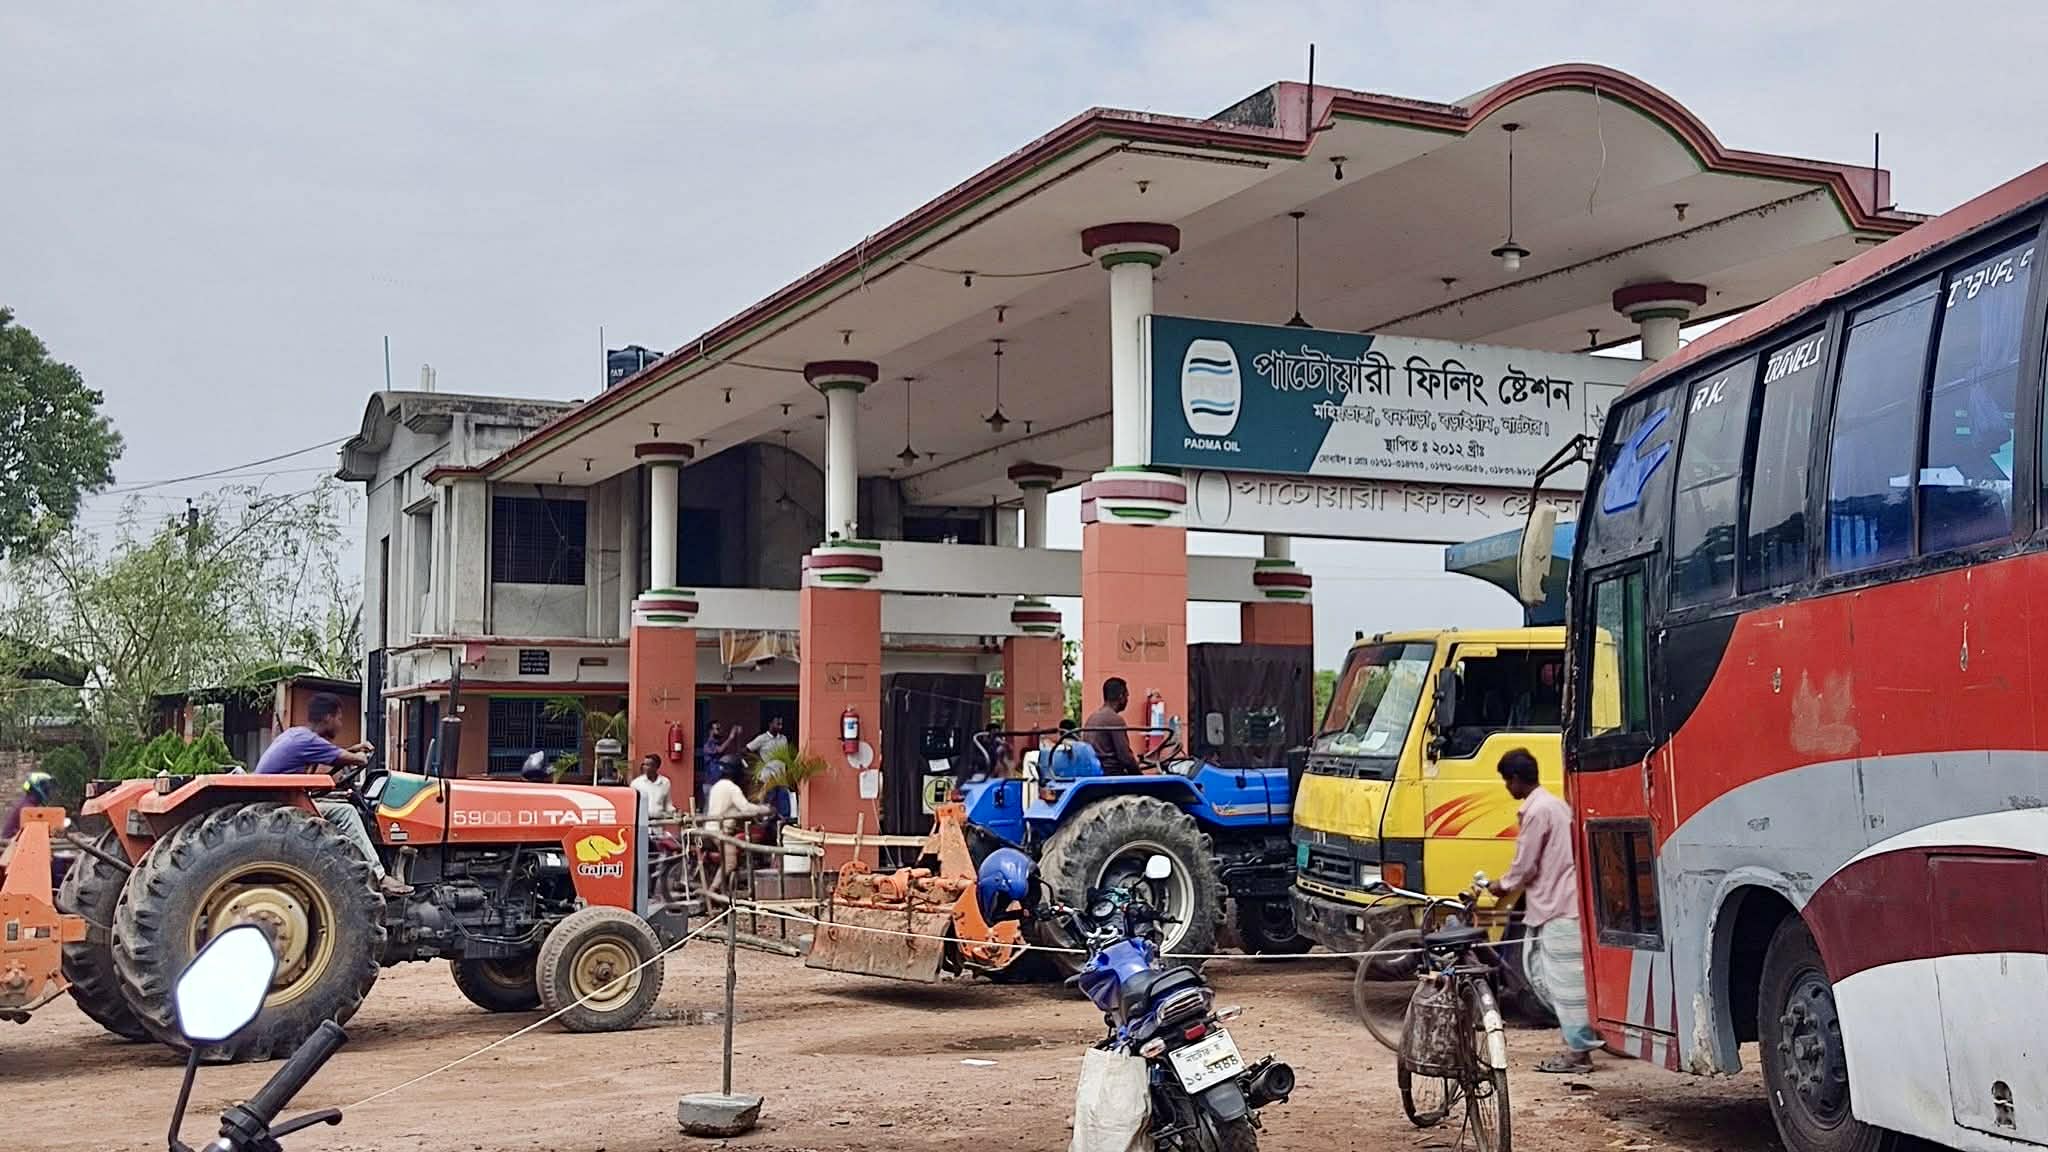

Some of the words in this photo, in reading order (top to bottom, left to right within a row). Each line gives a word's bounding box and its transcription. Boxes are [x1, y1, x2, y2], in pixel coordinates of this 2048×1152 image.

[1764, 336, 1824, 384] TRAVELS
[1253, 344, 1395, 396] পাটোয়ারী
[1403, 355, 1488, 406] ফিলিং
[1499, 364, 1573, 411] ষ্টেশন
[1184, 438, 1221, 451] PADMA
[1223, 440, 1241, 452] OIL
[1384, 435, 1418, 454] স্থাপিত
[1432, 441, 1464, 457] ২০১২
[1236, 479, 1388, 511] পাটোয়ারী
[1395, 483, 1490, 518] ফিলিং
[1503, 490, 1584, 519] ষ্টেন
[453, 810, 512, 825] 5900
[518, 810, 538, 825] DI
[543, 810, 617, 825] TAFE
[577, 861, 624, 879] Gajraj
